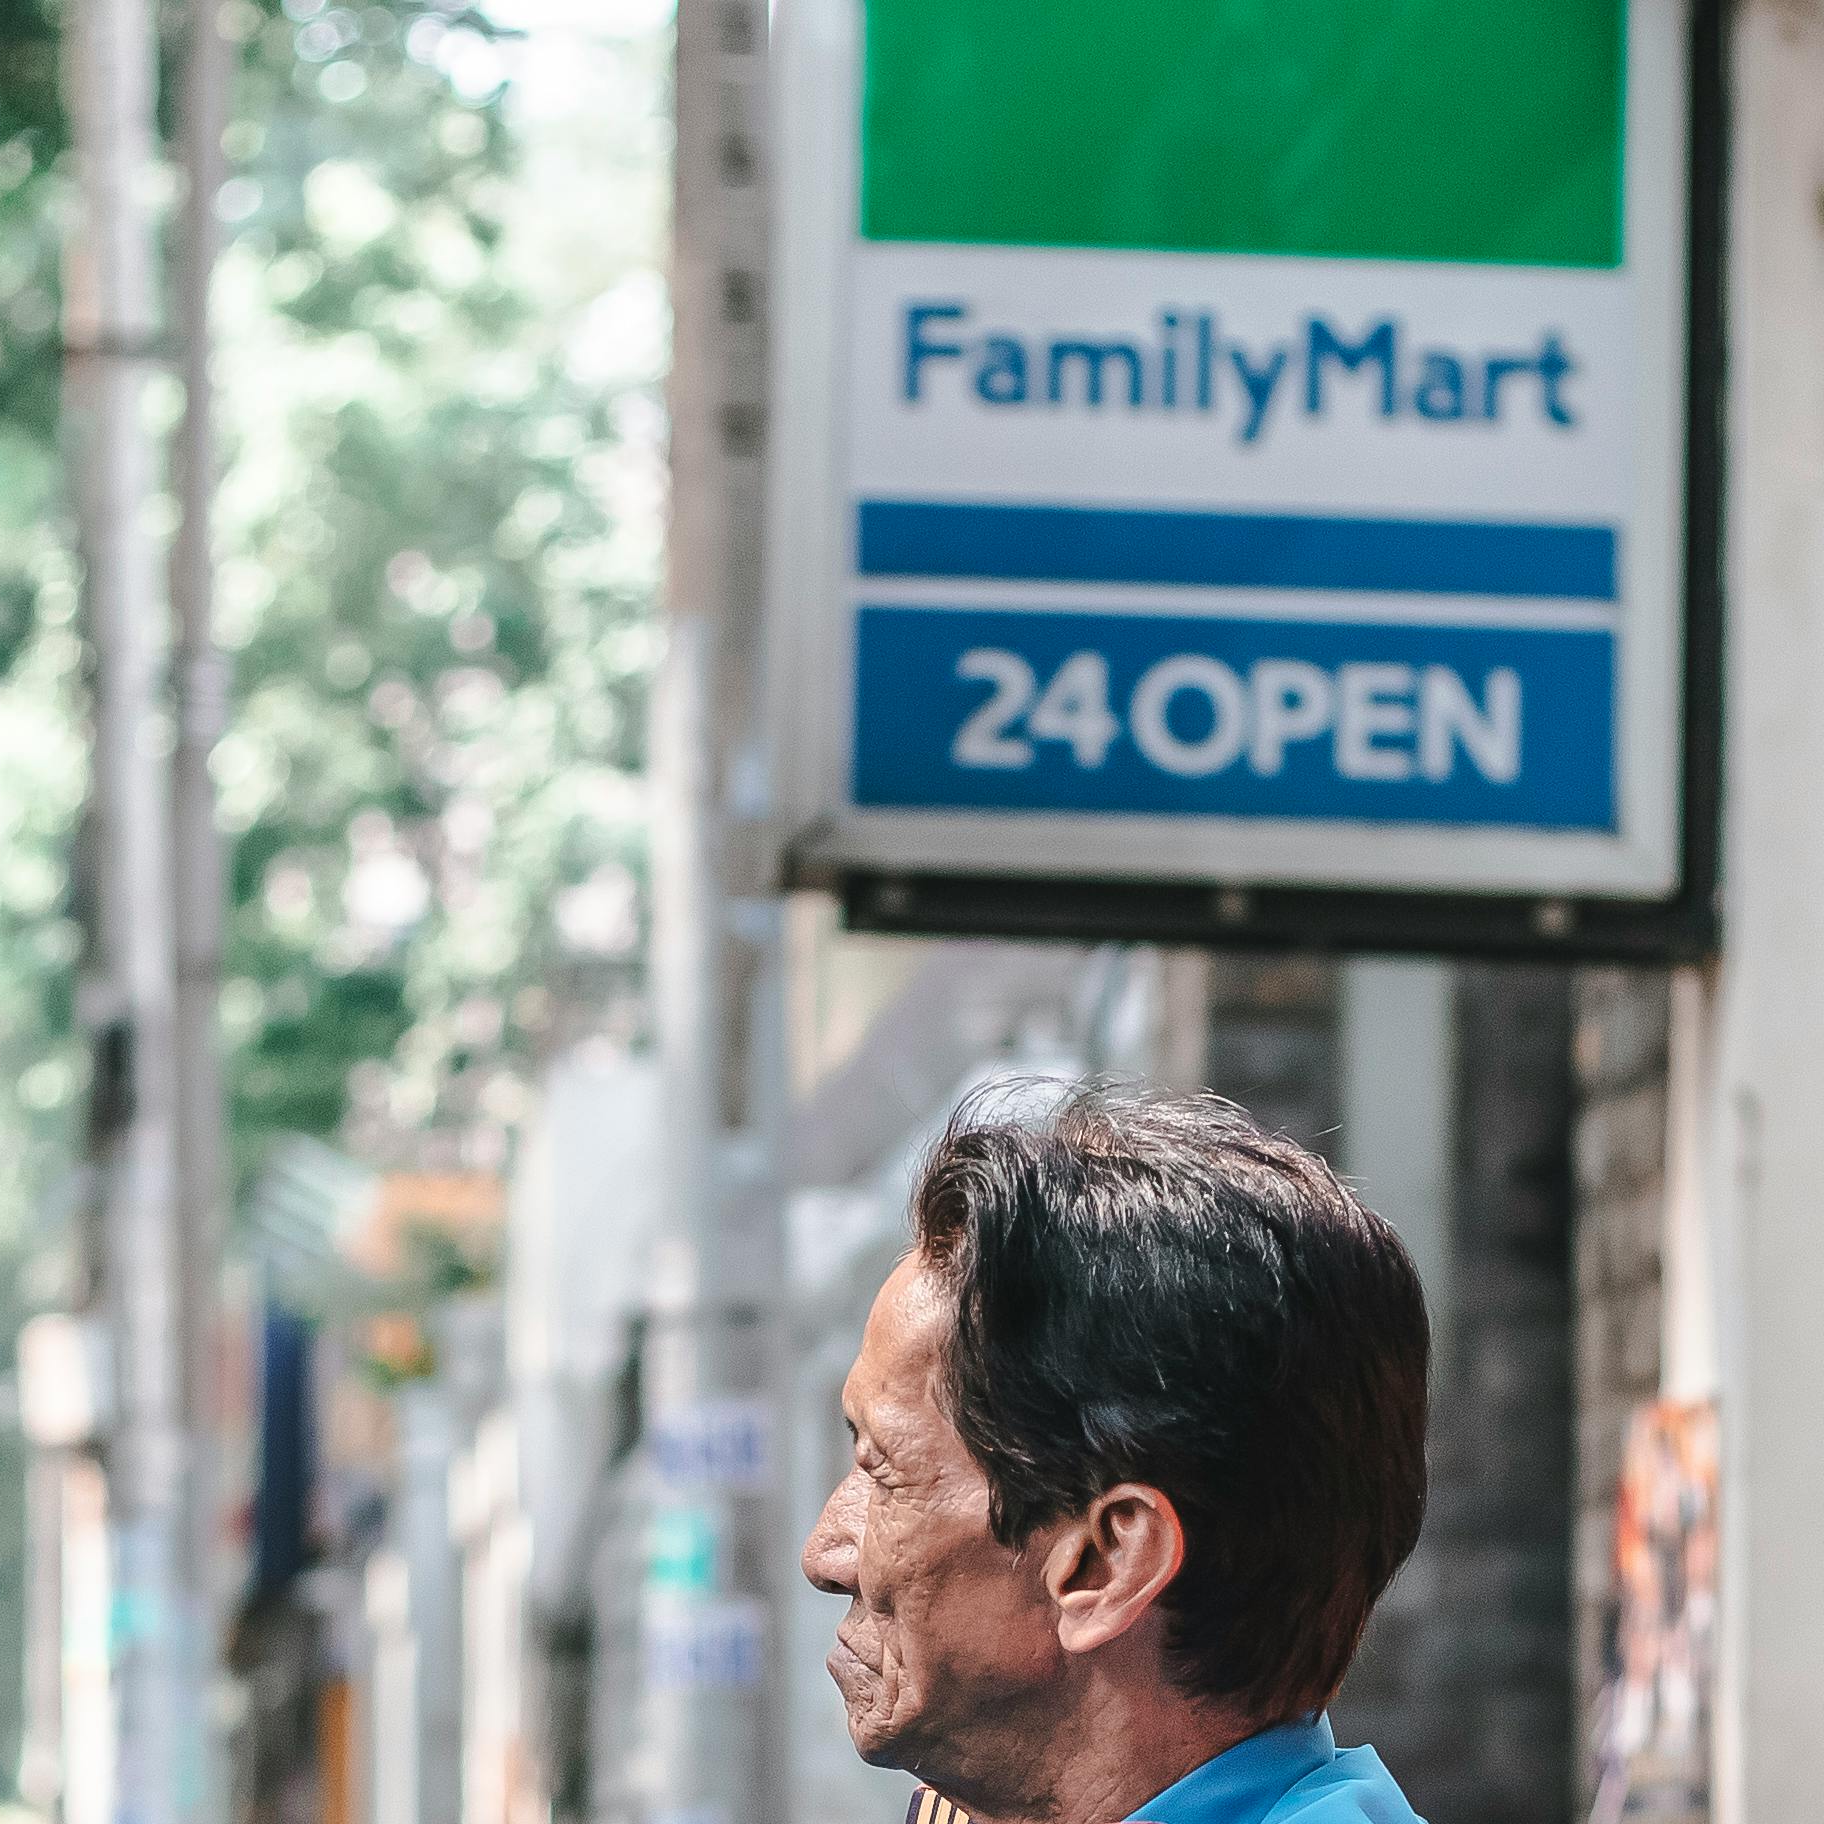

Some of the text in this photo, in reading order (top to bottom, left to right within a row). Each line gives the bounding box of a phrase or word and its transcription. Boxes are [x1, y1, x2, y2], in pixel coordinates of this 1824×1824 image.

[903, 299, 1579, 444] FamilyMart
[953, 648, 1521, 783] 24 OPEN
